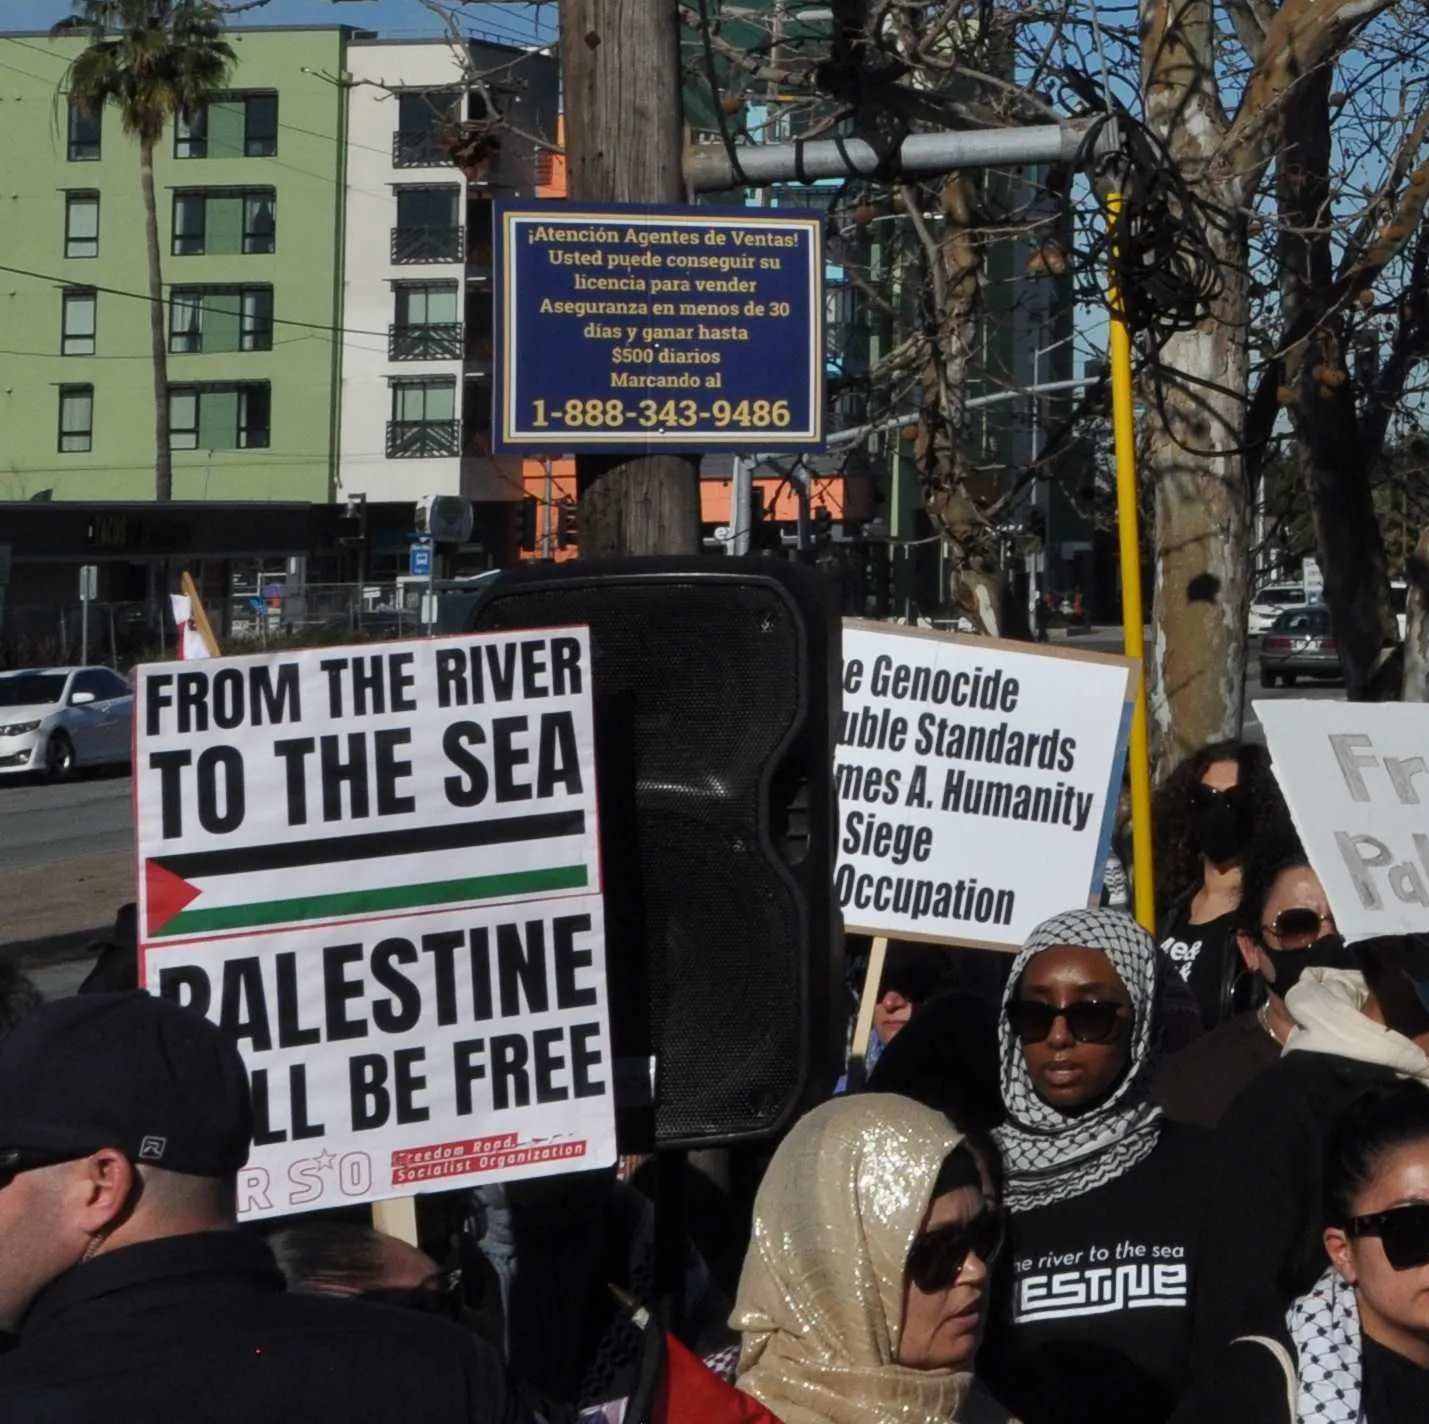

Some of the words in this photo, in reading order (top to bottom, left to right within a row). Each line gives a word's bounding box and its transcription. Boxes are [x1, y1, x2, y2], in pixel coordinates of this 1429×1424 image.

[528, 227, 617, 244] ¡Atención
[624, 229, 699, 246] Agentes
[704, 230, 726, 245] de
[731, 232, 799, 247] Ventas!
[549, 250, 603, 266] Usted
[608, 252, 661, 271] puede
[666, 254, 755, 271] conseguir
[760, 257, 781, 270] su
[574, 274, 645, 291] licencia
[650, 279, 690, 294] para
[695, 278, 757, 293] vender
[540, 298, 648, 317] Aseguranza
[653, 303, 675, 315] en
[680, 303, 739, 316] menos
[744, 302, 764, 316] de
[769, 302, 790, 317] 30
[584, 323, 621, 338] días
[627, 327, 637, 343] y
[642, 326, 693, 342] ganar
[698, 325, 748, 340] hasta
[612, 348, 653, 365] $500
[658, 348, 721, 364] diarios
[611, 373, 700, 388] Marcando
[705, 373, 722, 388] al
[532, 399, 791, 427] 1-888-343-9486
[146, 663, 301, 736] FROM
[320, 652, 417, 718] THE
[435, 637, 583, 708] RIVER
[870, 654, 1020, 713] Genocide
[839, 705, 908, 753] uble
[915, 712, 1077, 772] Standards
[149, 745, 245, 839] TO
[274, 727, 416, 826] THE
[442, 711, 584, 807] SEA
[836, 763, 902, 805] mes
[905, 764, 933, 809] A.
[940, 768, 1094, 831] Humanity
[842, 810, 933, 865] Siege
[835, 863, 1015, 926] Occupation
[349, 1046, 430, 1132] BE
[453, 1022, 606, 1116] FREE
[237, 1149, 373, 1214] RSO
[397, 1159, 470, 1182] Socialist
[479, 1143, 584, 1169] Organization
[1038, 1250, 1084, 1268] river
[1089, 1245, 1110, 1262] to
[1115, 1240, 1147, 1260] the
[1151, 1245, 1185, 1258] sea
